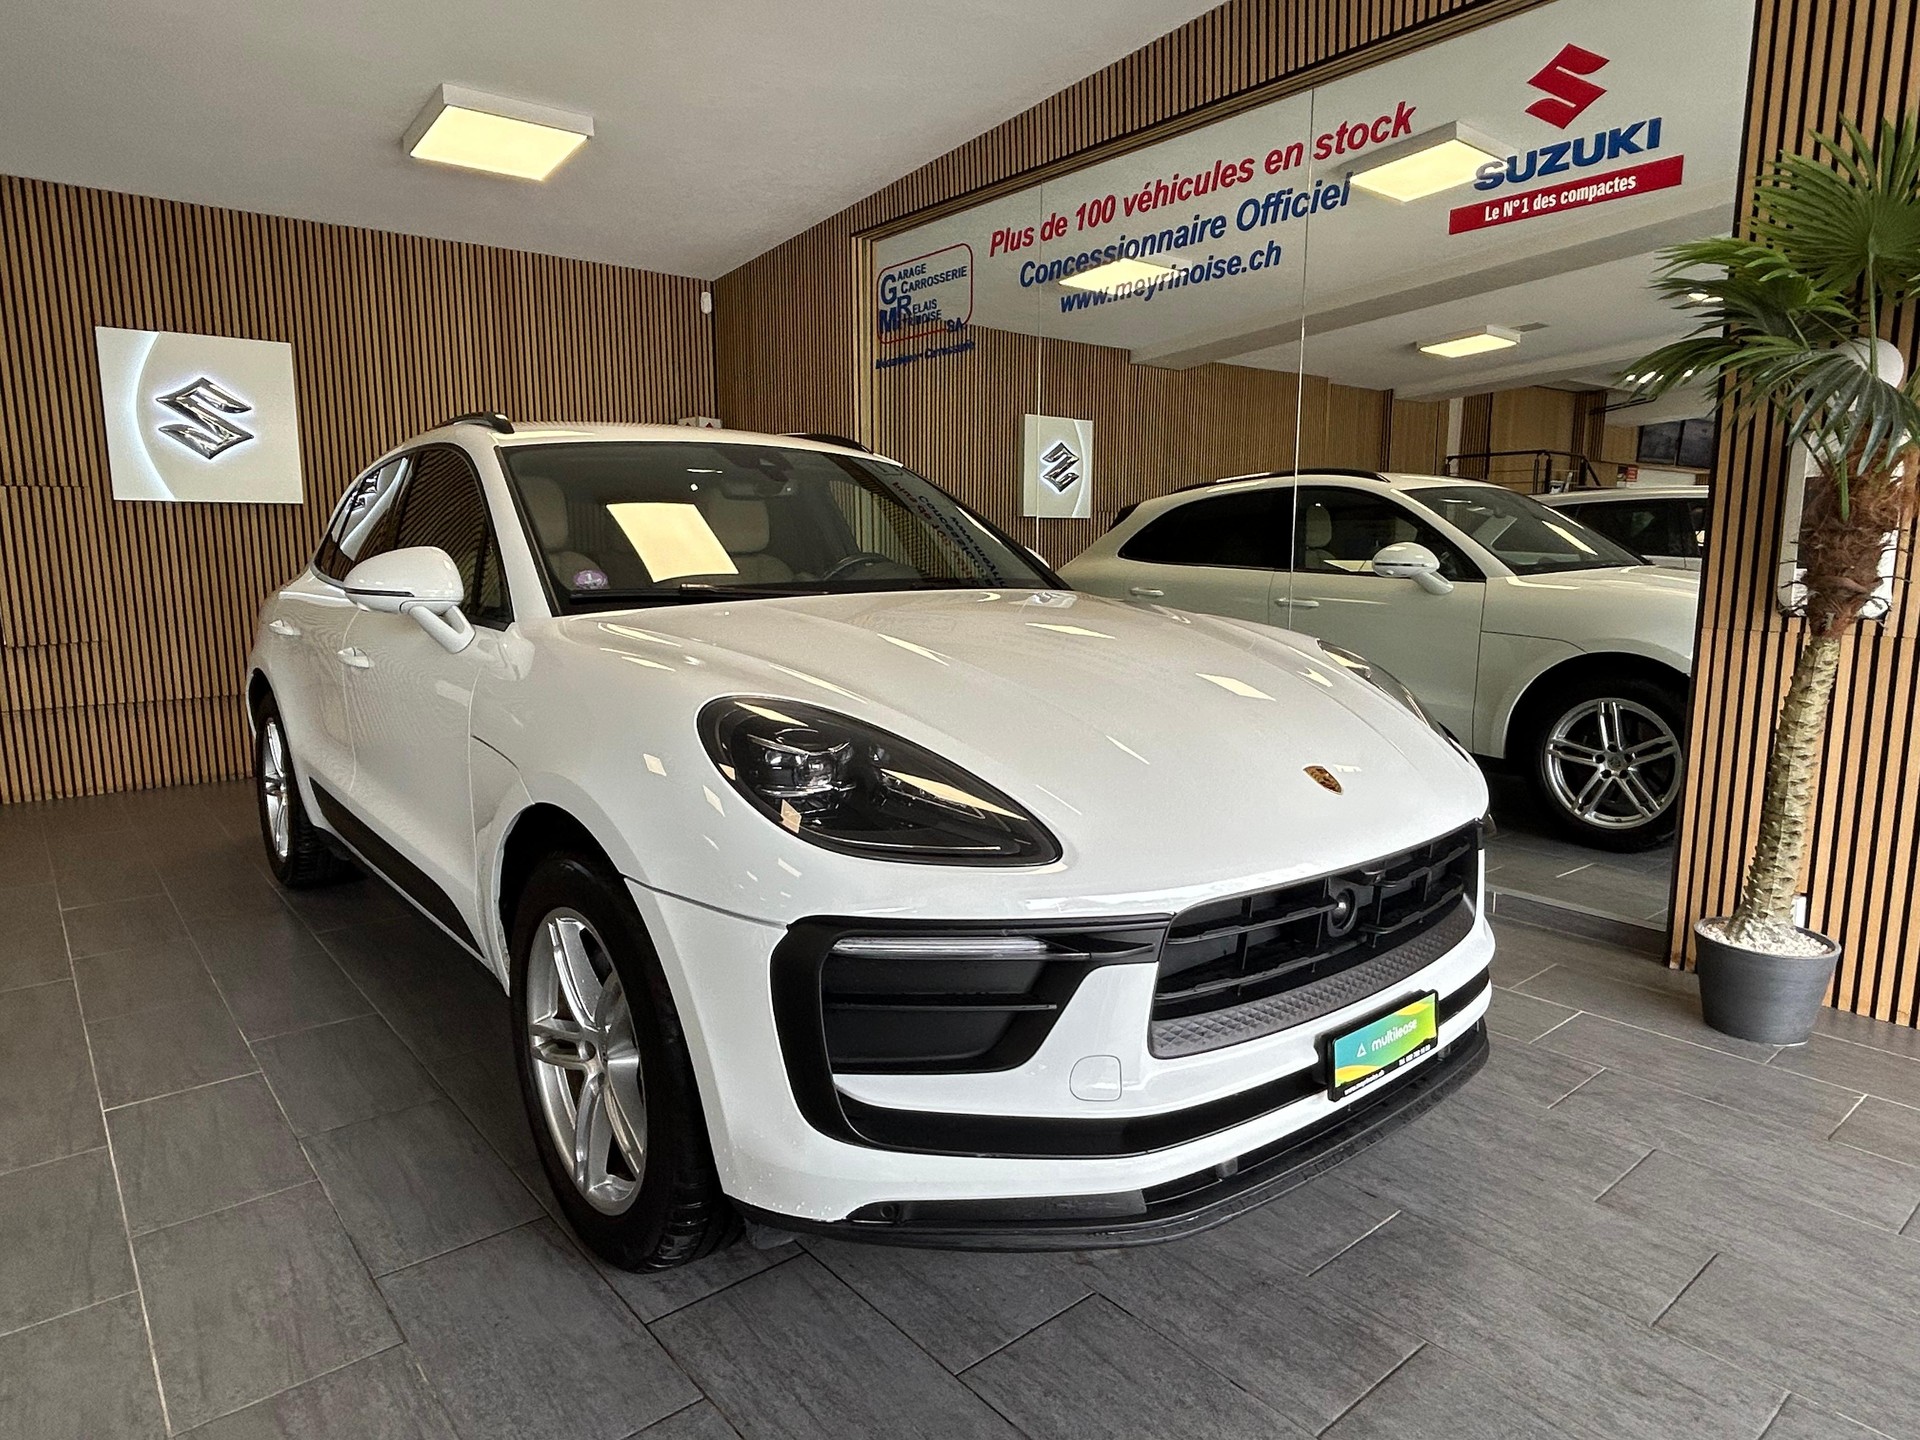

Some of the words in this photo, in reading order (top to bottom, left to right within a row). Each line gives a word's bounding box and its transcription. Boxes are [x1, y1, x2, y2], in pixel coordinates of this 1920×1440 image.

[1473, 117, 1662, 191] SUZUKI
[989, 226, 1035, 257] Plus
[1040, 213, 1068, 241] de
[1075, 195, 1116, 231] 100
[1123, 157, 1256, 217] véhicules
[1264, 142, 1304, 174] en
[1313, 101, 1417, 160] stock
[1484, 205, 1500, 222] Le
[1503, 199, 1529, 218] N°1
[1533, 193, 1557, 211] des
[1560, 175, 1637, 202] compactes
[1020, 214, 1227, 287] Concessionnaire
[1236, 172, 1354, 231] Officiel
[880, 263, 926, 305] GARAGE
[901, 266, 968, 294] CARROSSERIE
[1060, 241, 1282, 313] www.meyrinoise.ch
[879, 309, 942, 335] MYRINOISE
[896, 294, 938, 319] RELAIS
[946, 317, 963, 333] SA
[1371, 1019, 1418, 1051] multilease
